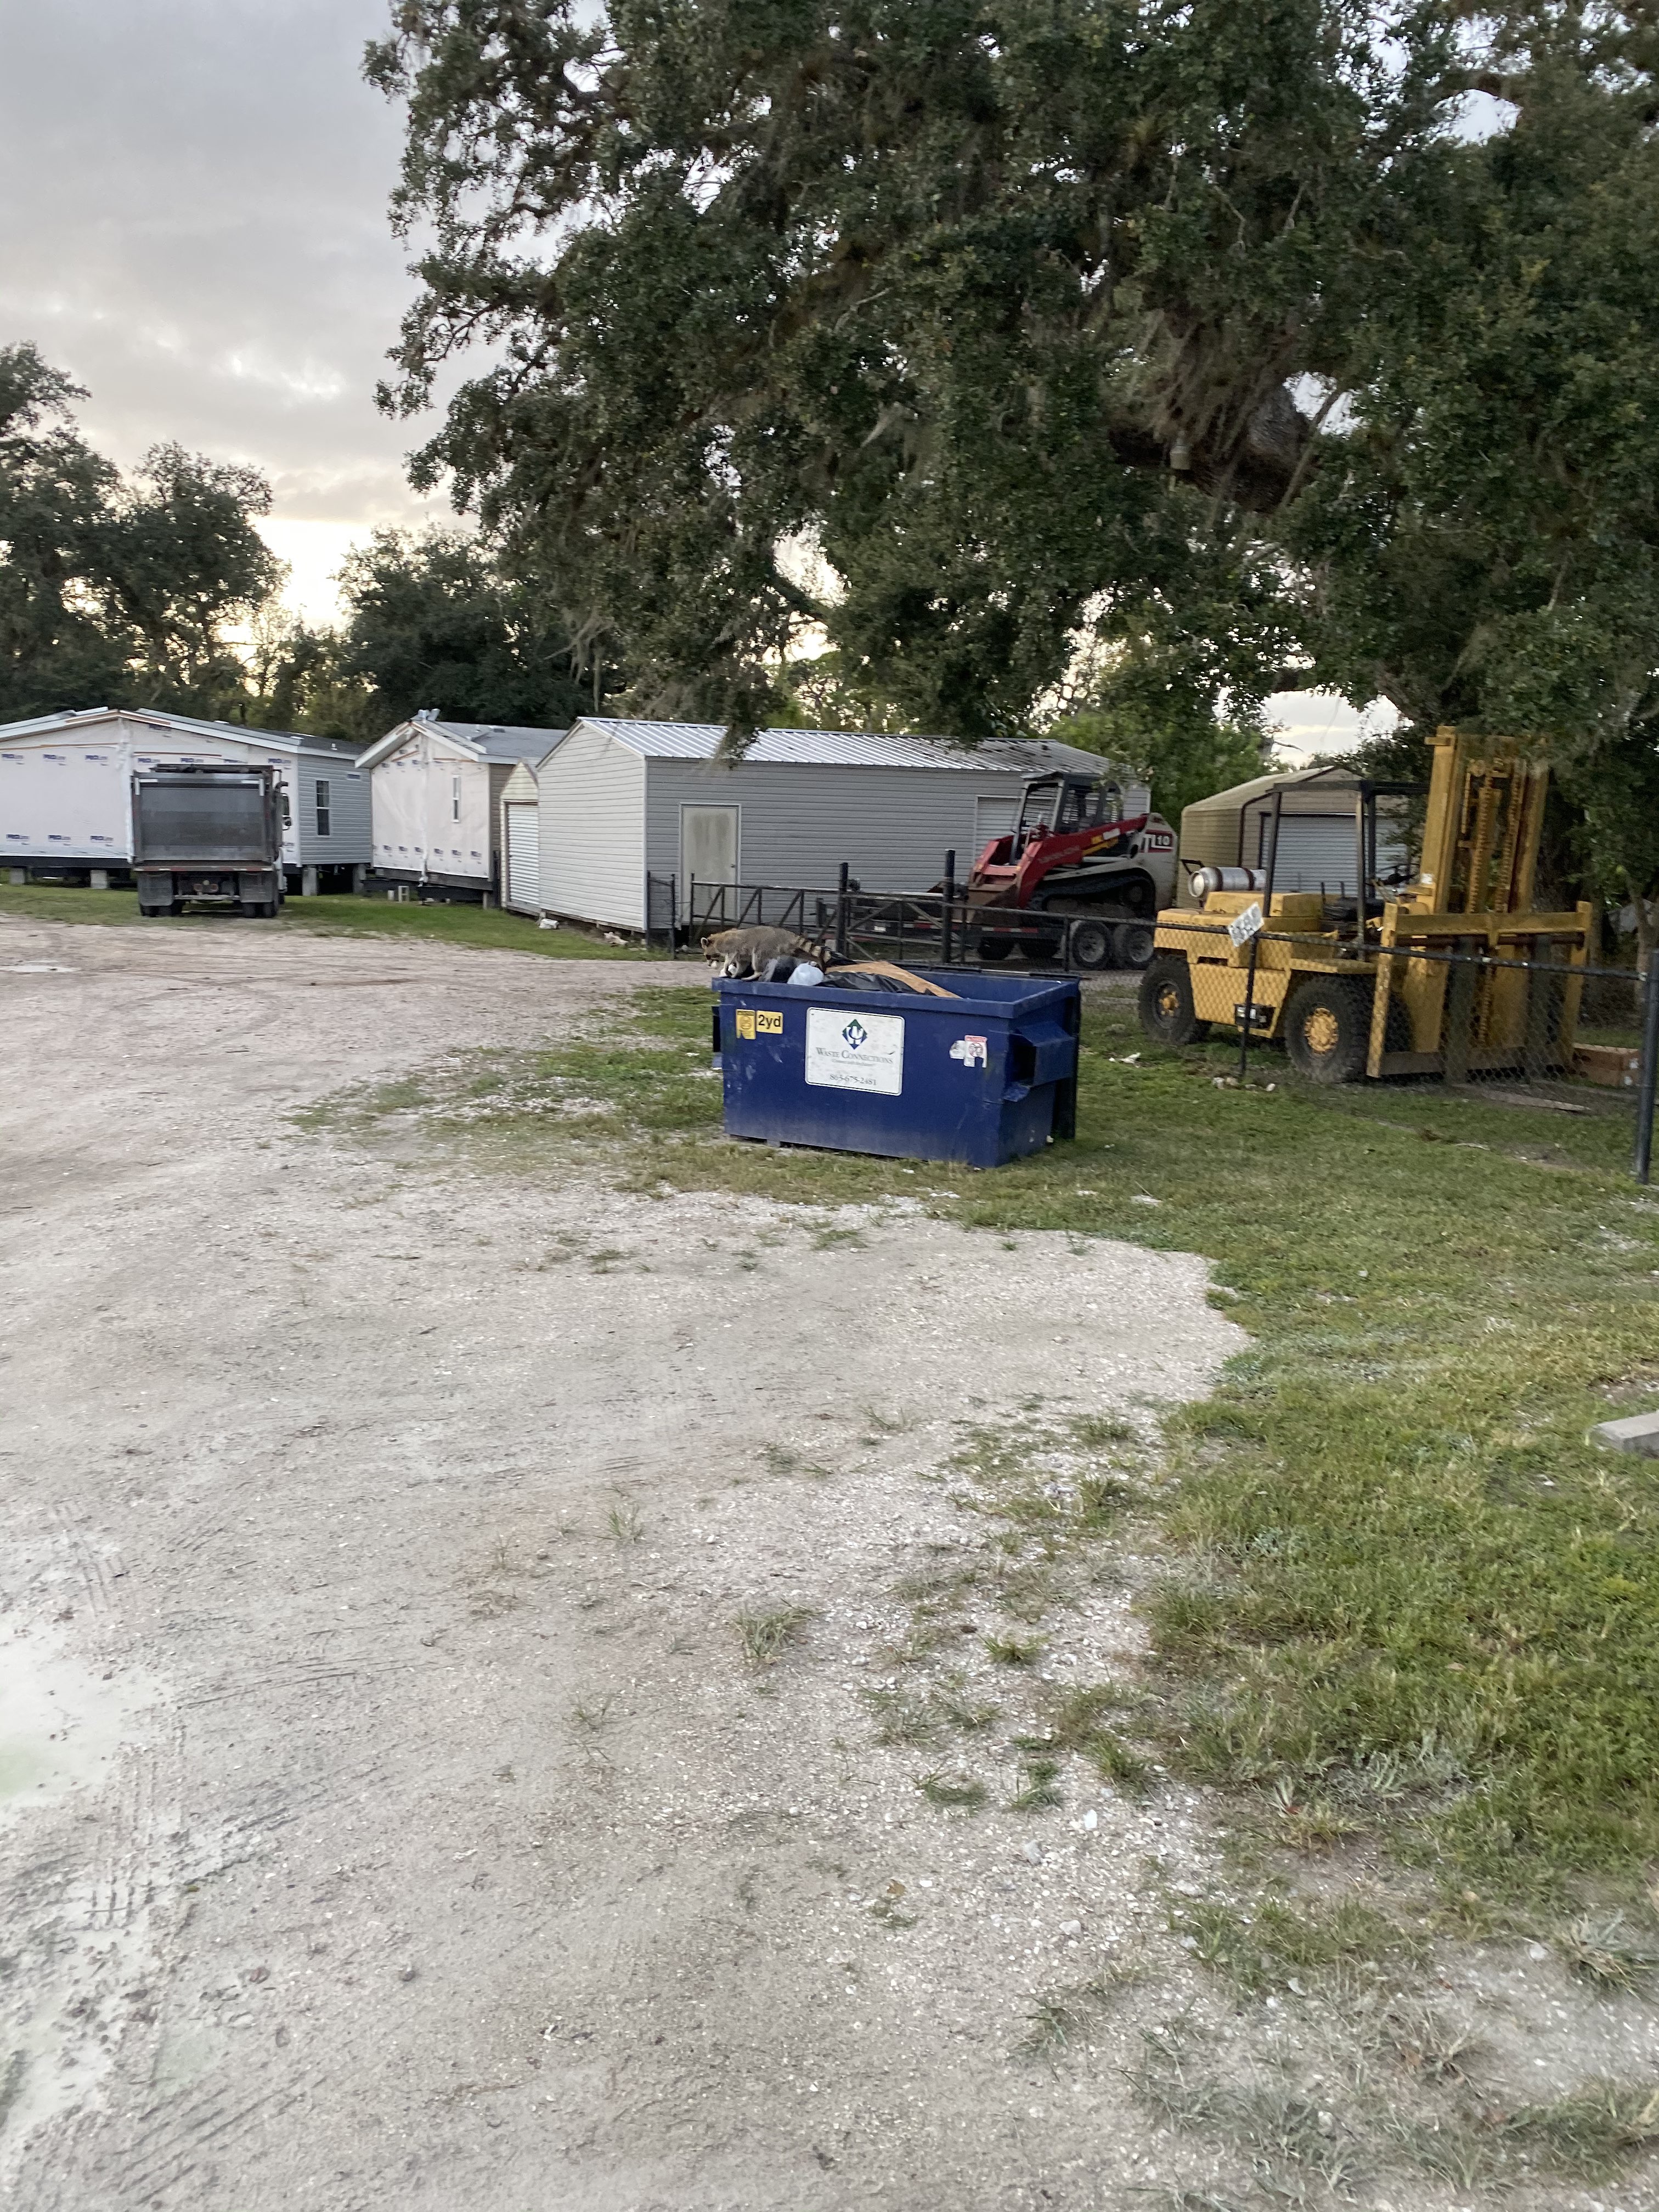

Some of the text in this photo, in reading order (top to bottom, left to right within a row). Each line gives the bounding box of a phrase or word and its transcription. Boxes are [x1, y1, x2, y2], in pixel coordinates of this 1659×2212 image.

[1143, 834, 1174, 853] TL10
[758, 1014, 781, 1030] 2yd
[816, 1047, 840, 1058] WASTE
[842, 1050, 893, 1064] CONNECTIONS
